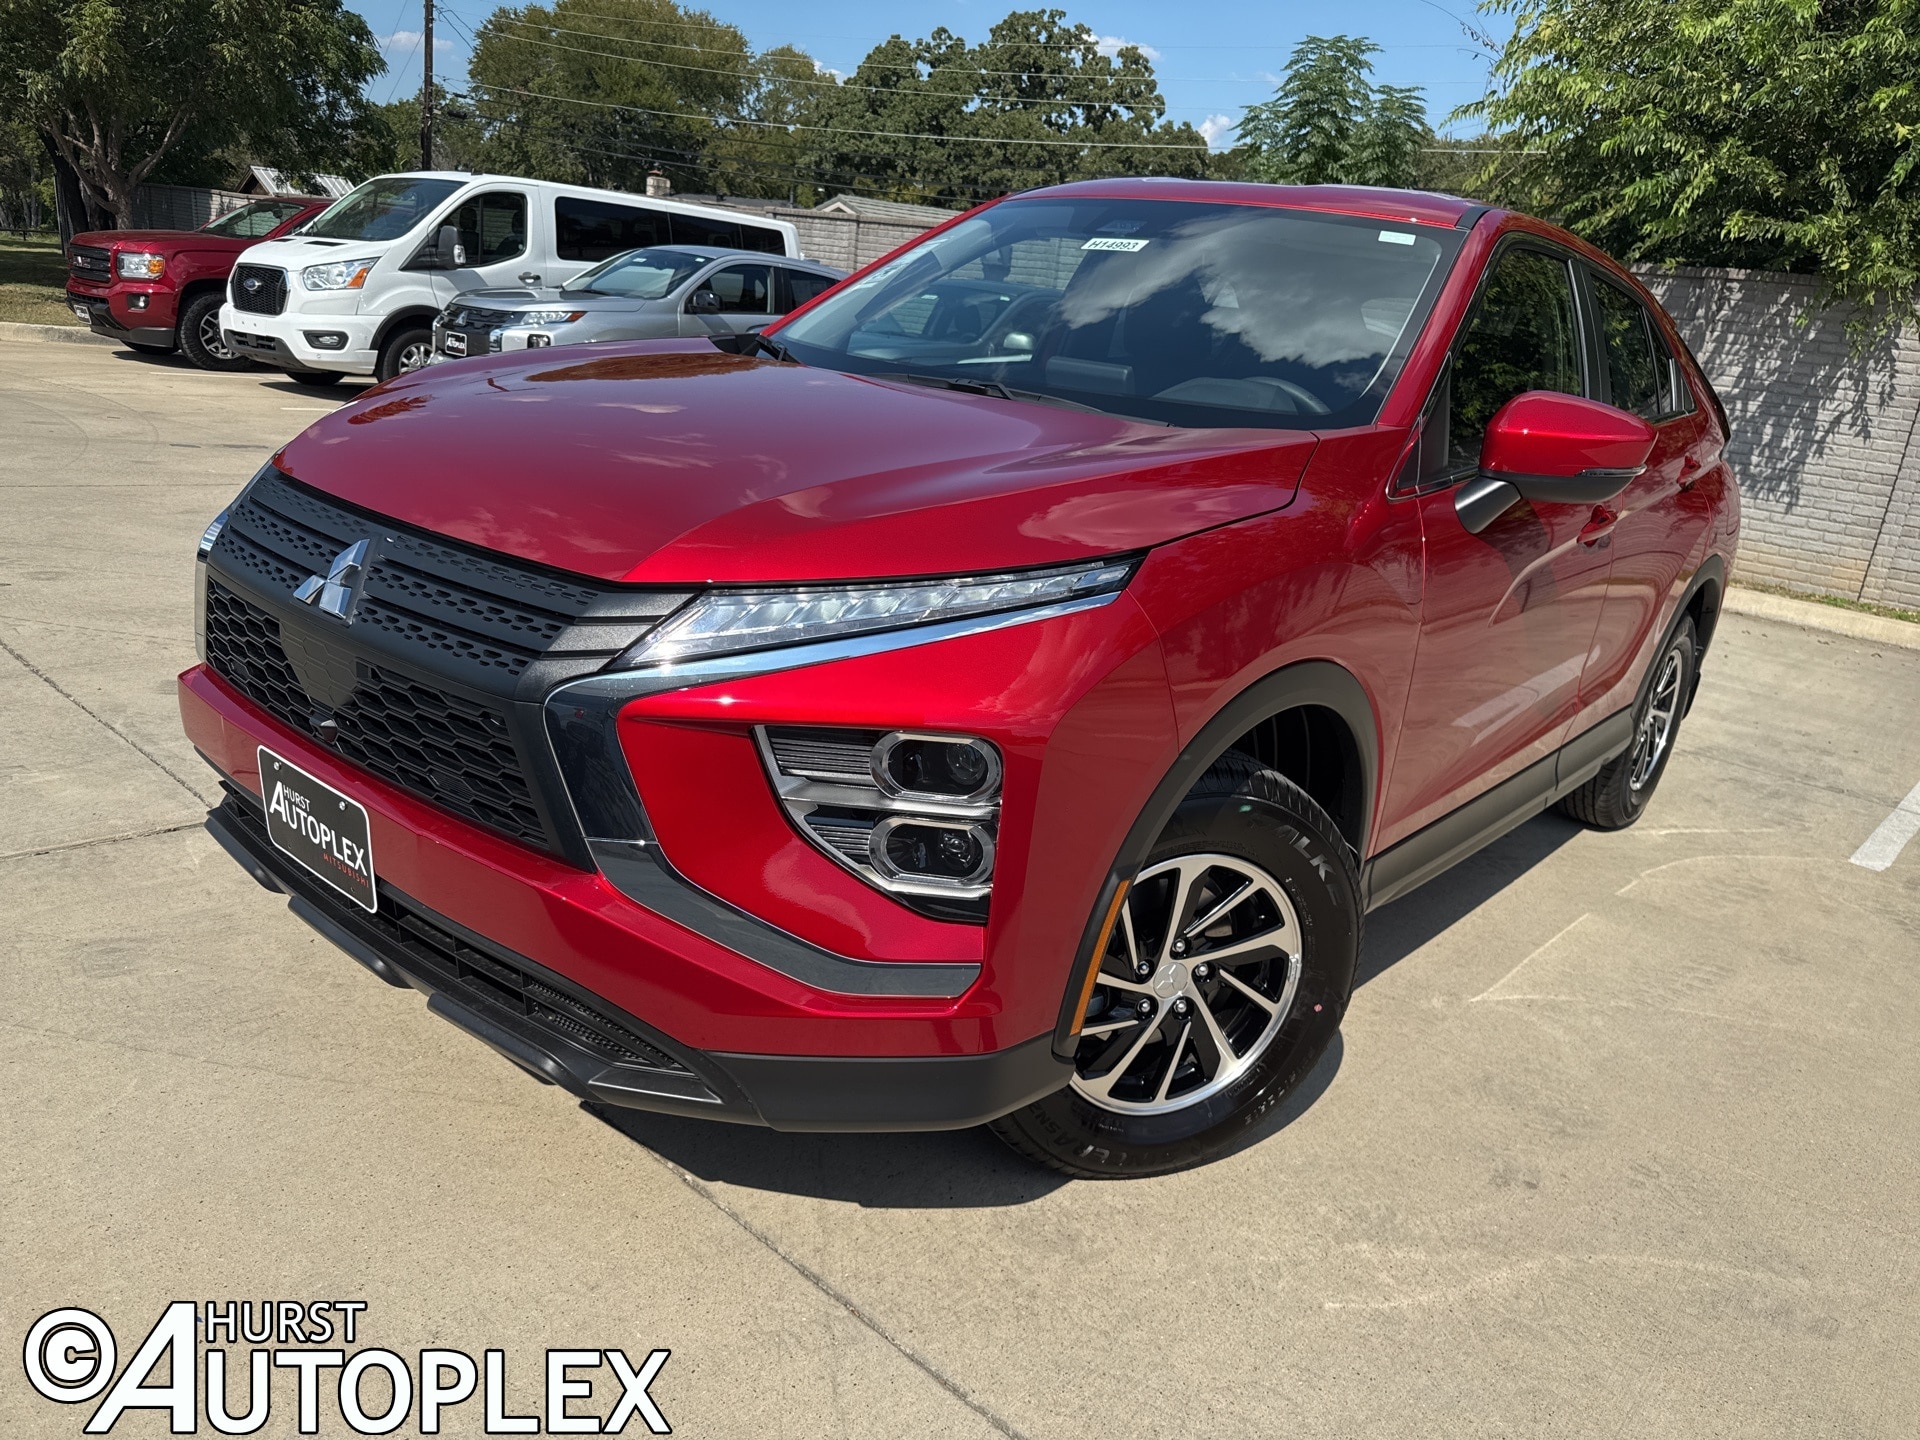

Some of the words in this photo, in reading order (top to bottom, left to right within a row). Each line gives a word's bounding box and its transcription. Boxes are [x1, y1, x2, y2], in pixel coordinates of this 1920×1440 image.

[1087, 240, 1139, 250] H14993
[284, 786, 311, 811] HURST
[269, 781, 367, 876] AUTOPLEX
[324, 854, 369, 887] MITSUBISHI
